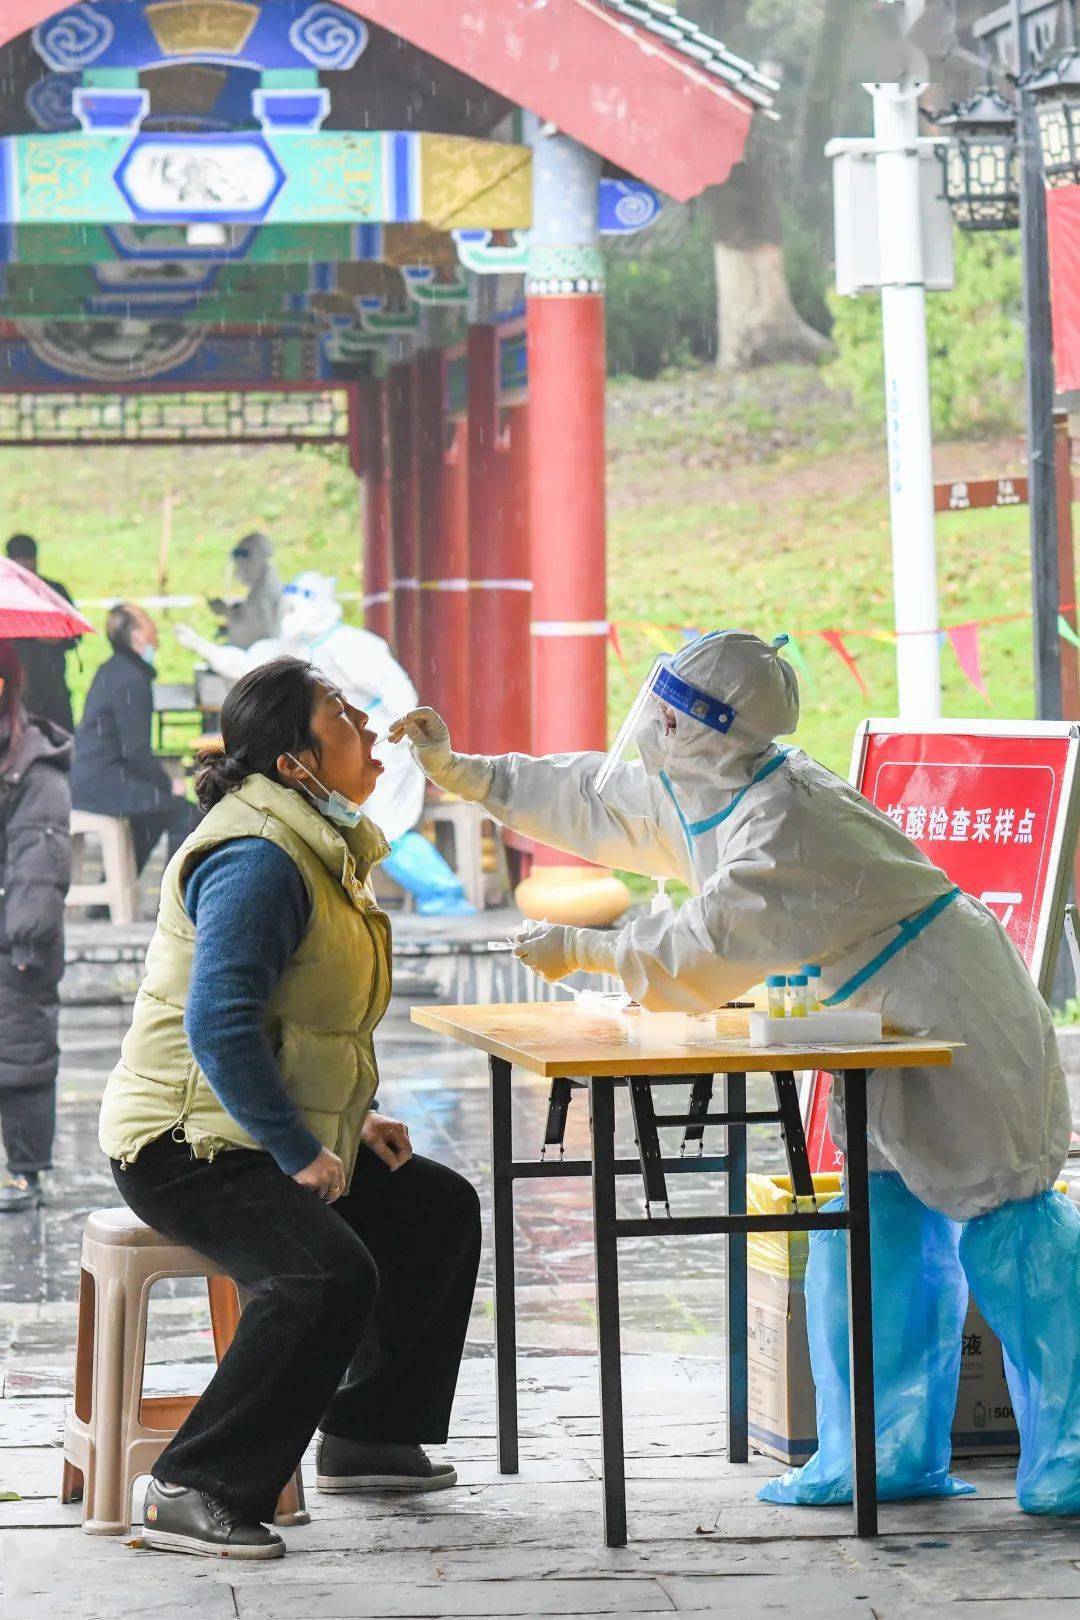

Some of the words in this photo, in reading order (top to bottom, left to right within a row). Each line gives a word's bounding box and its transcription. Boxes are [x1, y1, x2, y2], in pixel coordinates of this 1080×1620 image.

[886, 803, 1036, 844] 核酸检查采样点
